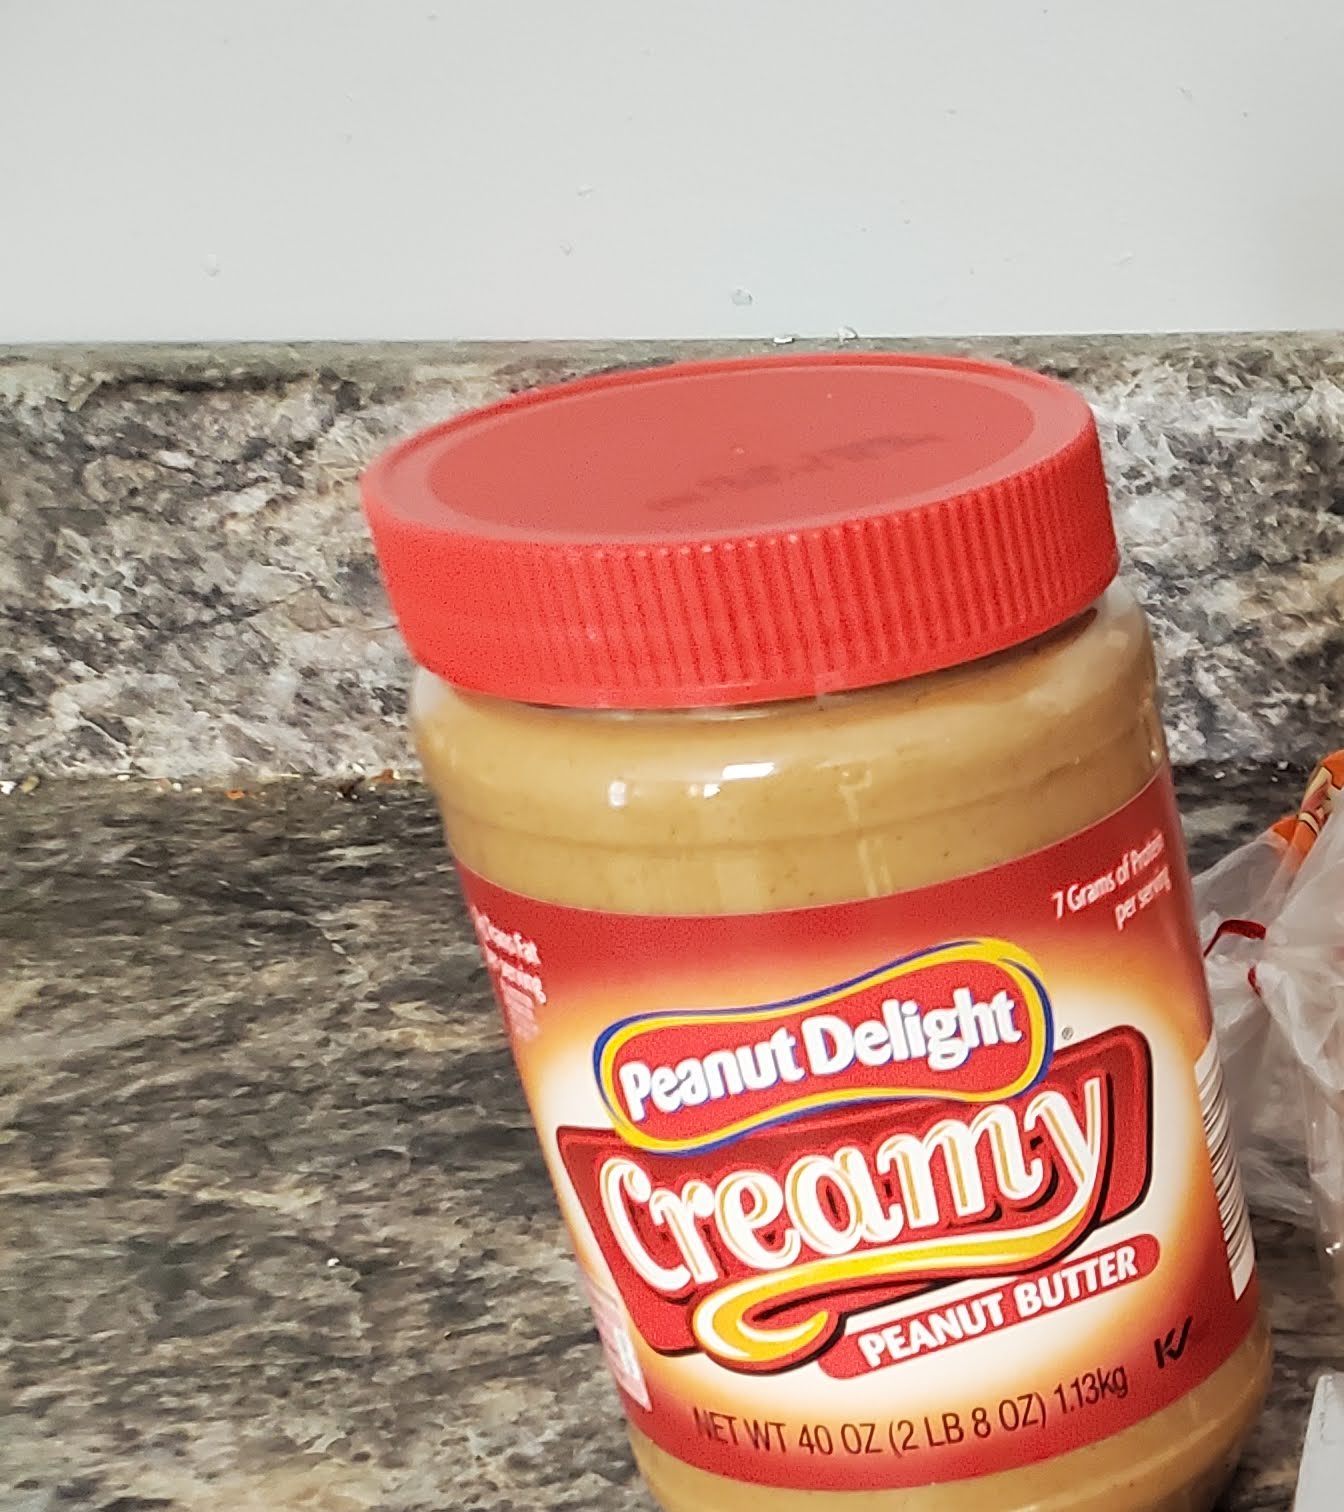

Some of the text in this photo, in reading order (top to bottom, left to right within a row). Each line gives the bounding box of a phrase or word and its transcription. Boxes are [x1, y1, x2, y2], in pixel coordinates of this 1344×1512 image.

[1051, 890, 1064, 919] 7
[1067, 872, 1117, 912] Grams
[1115, 852, 1131, 886] of
[619, 987, 1024, 1121] Peanut Delight
[598, 1076, 1103, 1292] Creamy
[857, 1244, 1140, 1369] PEANUT BUTTER
[693, 1364, 1129, 1457] NET WT 40 OZ (2 LB 8 OZ) 1.13kg
